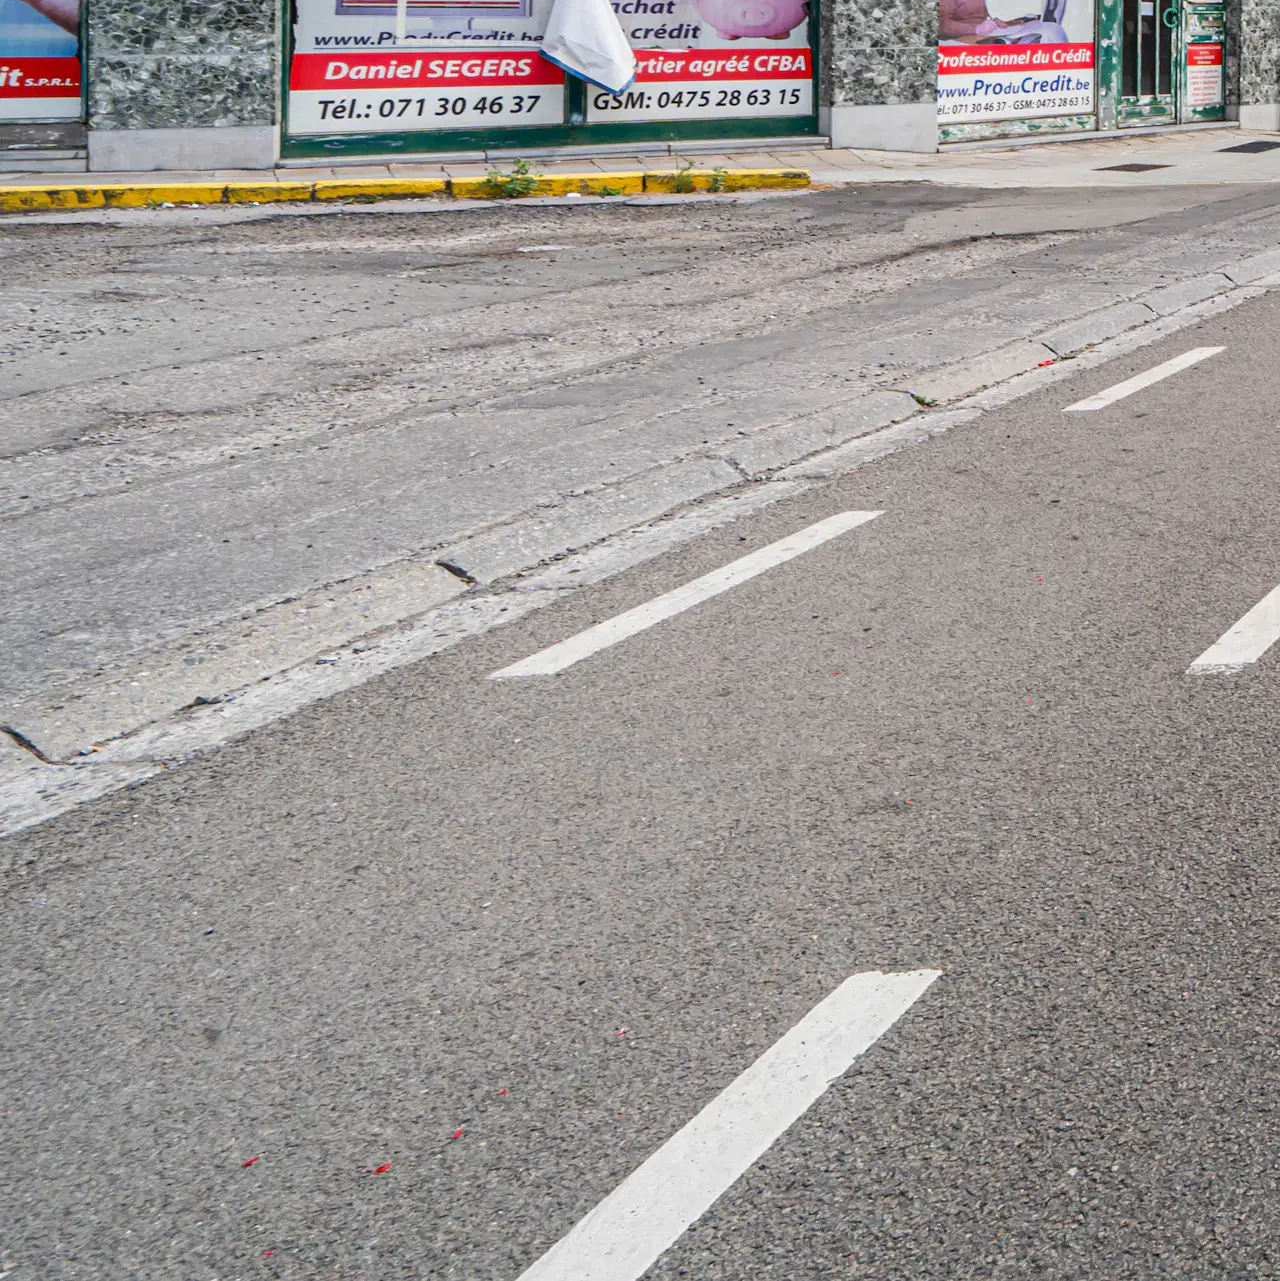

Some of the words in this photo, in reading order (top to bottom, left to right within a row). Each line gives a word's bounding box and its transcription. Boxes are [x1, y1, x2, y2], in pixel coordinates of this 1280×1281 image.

[631, 24, 700, 40] crédit
[637, 56, 686, 74] rtier
[689, 55, 749, 77] agréé
[754, 56, 806, 72] CFBA
[938, 50, 1031, 67] Professionnel
[1032, 50, 1049, 64] du
[1052, 48, 1091, 63] Crédit
[324, 60, 423, 80] Daniel
[427, 58, 532, 78] SEGERS
[25, 77, 80, 87] S.P.R.L.
[937, 74, 1090, 98] www.ProduCredit.be
[318, 99, 372, 120] Tél.:
[379, 98, 426, 118] 071
[434, 96, 467, 116] 30
[472, 95, 503, 115] 46
[509, 95, 541, 114] 37
[594, 91, 652, 111] GSM:
[657, 91, 711, 109] 0475
[715, 90, 741, 107] 28
[746, 89, 771, 106] 63
[779, 88, 801, 105] 15
[937, 105, 950, 116] él.:
[952, 103, 968, 115] 071
[970, 103, 982, 113] 30
[984, 102, 994, 112] 46
[996, 101, 1006, 111] 37
[1013, 99, 1035, 111] GSM:
[1036, 98, 1056, 109] 0475
[1057, 97, 1067, 107] 28
[1068, 96, 1079, 106] 63
[1080, 96, 1090, 106] 15
